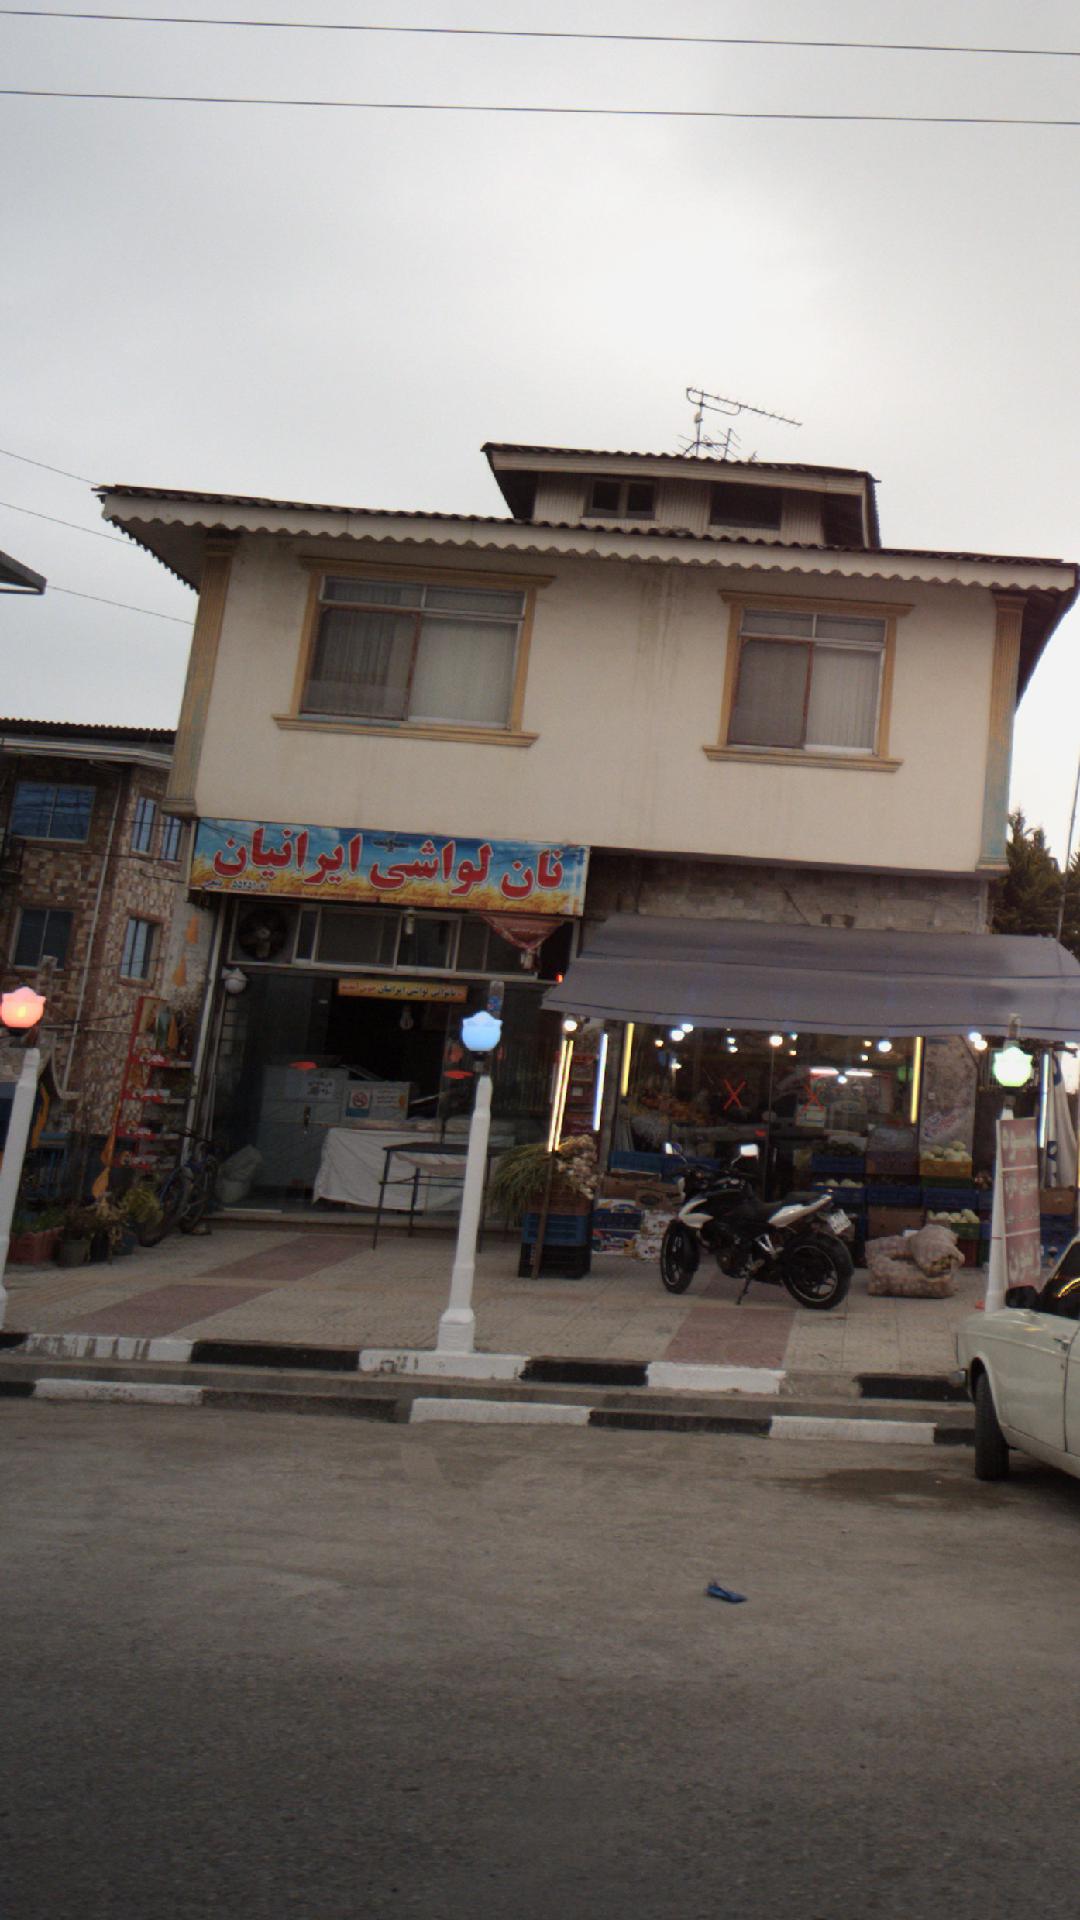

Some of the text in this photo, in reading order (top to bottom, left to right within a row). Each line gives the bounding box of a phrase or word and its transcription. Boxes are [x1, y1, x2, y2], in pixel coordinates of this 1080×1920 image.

[213, 825, 564, 899] نان لواشی ایرانیان
